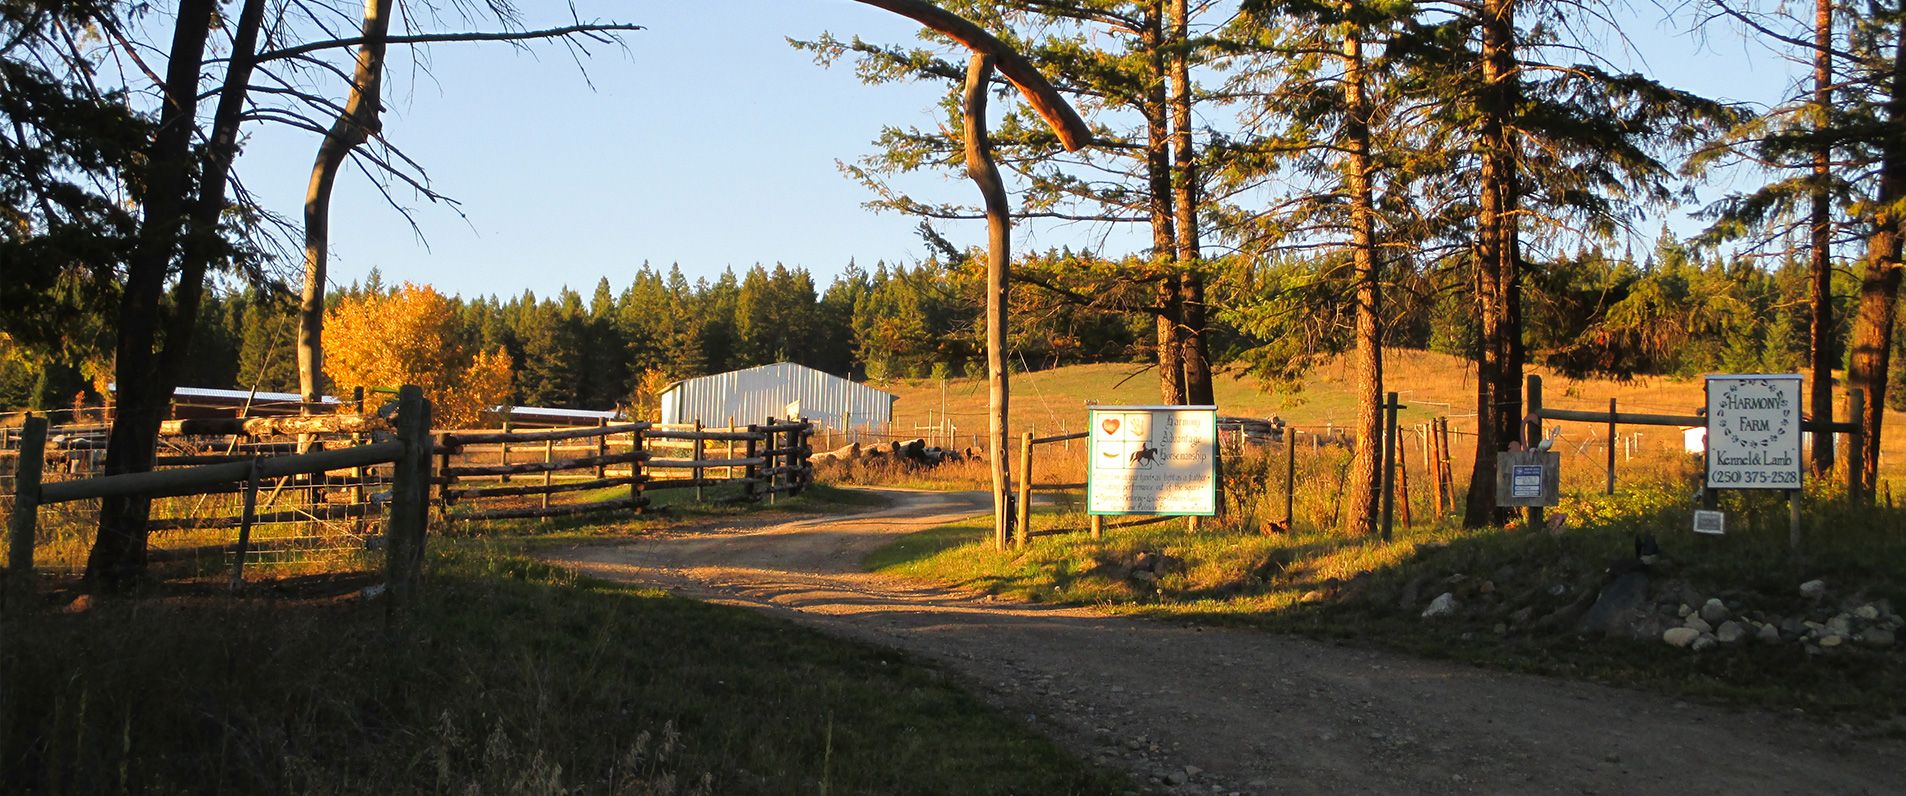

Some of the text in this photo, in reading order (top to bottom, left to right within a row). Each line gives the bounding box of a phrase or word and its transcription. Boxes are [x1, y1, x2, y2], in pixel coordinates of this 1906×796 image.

[1728, 394, 1781, 410] HARMONY
[1739, 416, 1770, 432] FARM
[1763, 450, 1792, 466] Lamb
[1711, 470, 1797, 484] (250) 375-2528
